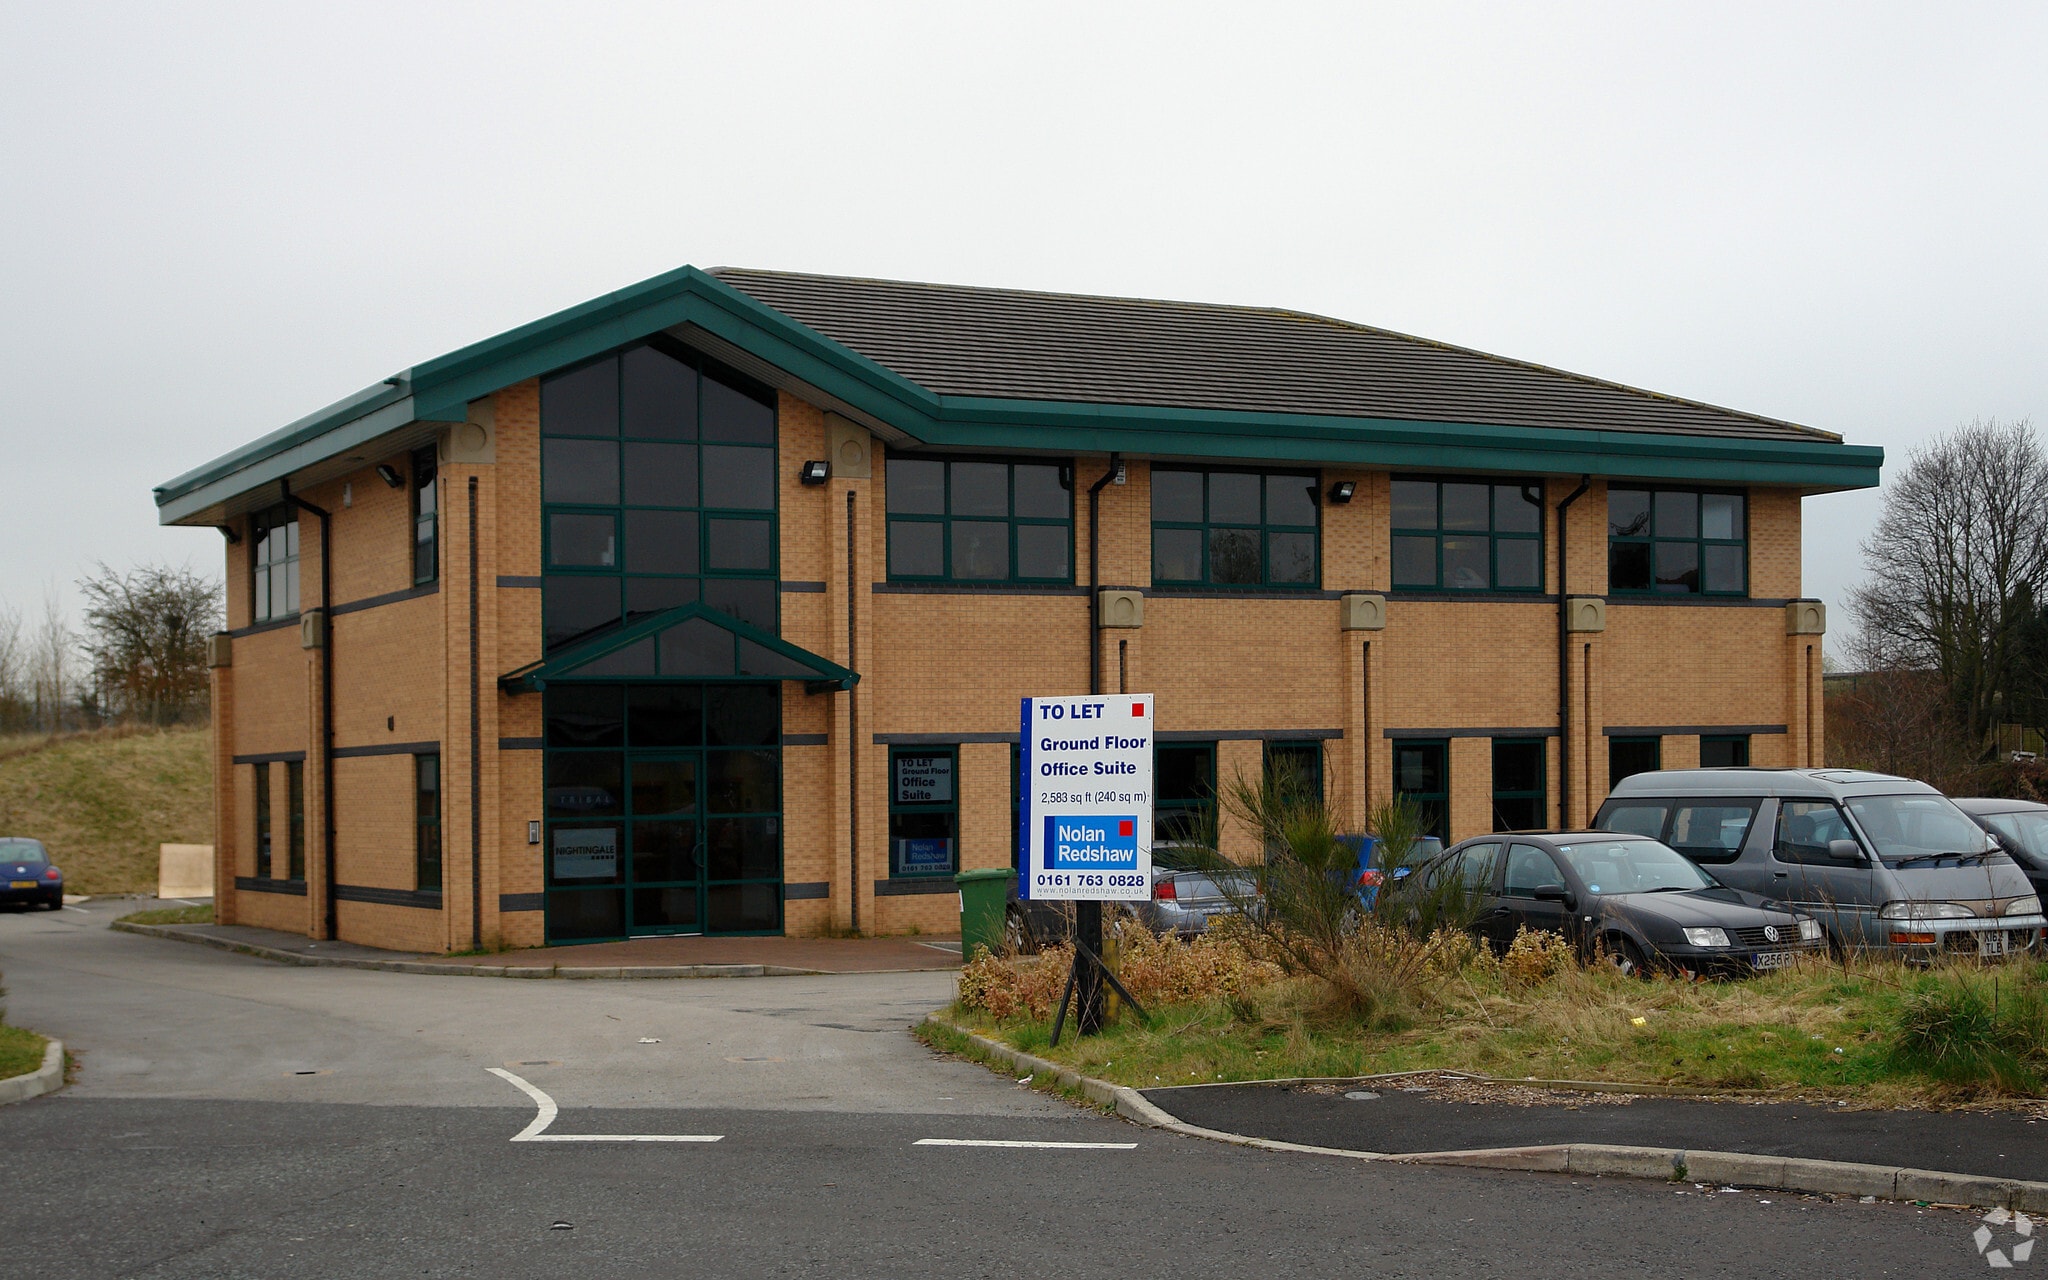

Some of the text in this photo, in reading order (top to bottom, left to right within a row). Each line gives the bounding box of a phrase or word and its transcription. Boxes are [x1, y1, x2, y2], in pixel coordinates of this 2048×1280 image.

[1040, 704, 1104, 720] TO LET
[1040, 735, 1146, 751] Ground Floor
[901, 758, 934, 767] TO LET
[1040, 761, 1137, 776] Office Suite
[902, 767, 950, 775] Ground Floor
[902, 777, 936, 787] Office
[560, 795, 609, 804] TRIBAL
[902, 789, 931, 800] Suite
[1041, 791, 1147, 805] 2,583 sq ft (240 sq m)
[1058, 825, 1105, 842] Nolan
[555, 845, 615, 855] NIGHTINGALE
[1058, 845, 1134, 862] Redshaw
[1037, 874, 1145, 887] 0161 763 0828
[1036, 887, 1144, 895] www.nolanredshaw.co.uk
